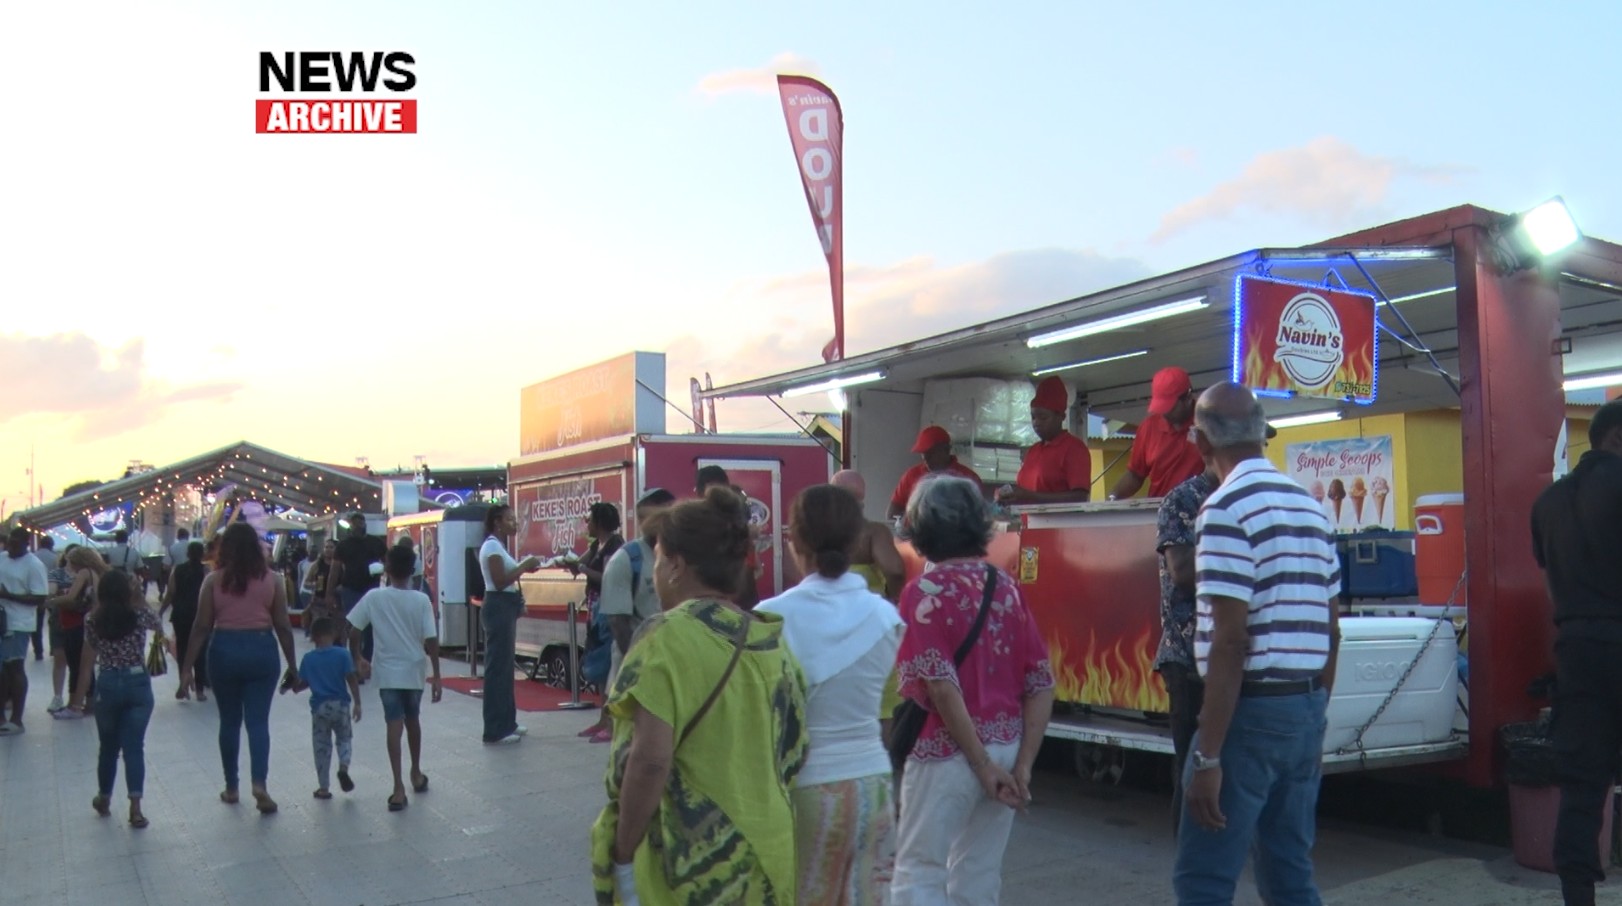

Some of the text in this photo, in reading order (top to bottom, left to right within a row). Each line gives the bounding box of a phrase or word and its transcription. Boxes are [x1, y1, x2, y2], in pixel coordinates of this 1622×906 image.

[1279, 326, 1341, 349] Navin's
[1297, 450, 1336, 478] Simple
[1339, 449, 1383, 475] Scoops
[533, 501, 565, 519] KEKE'S
[552, 520, 576, 554] Fish
